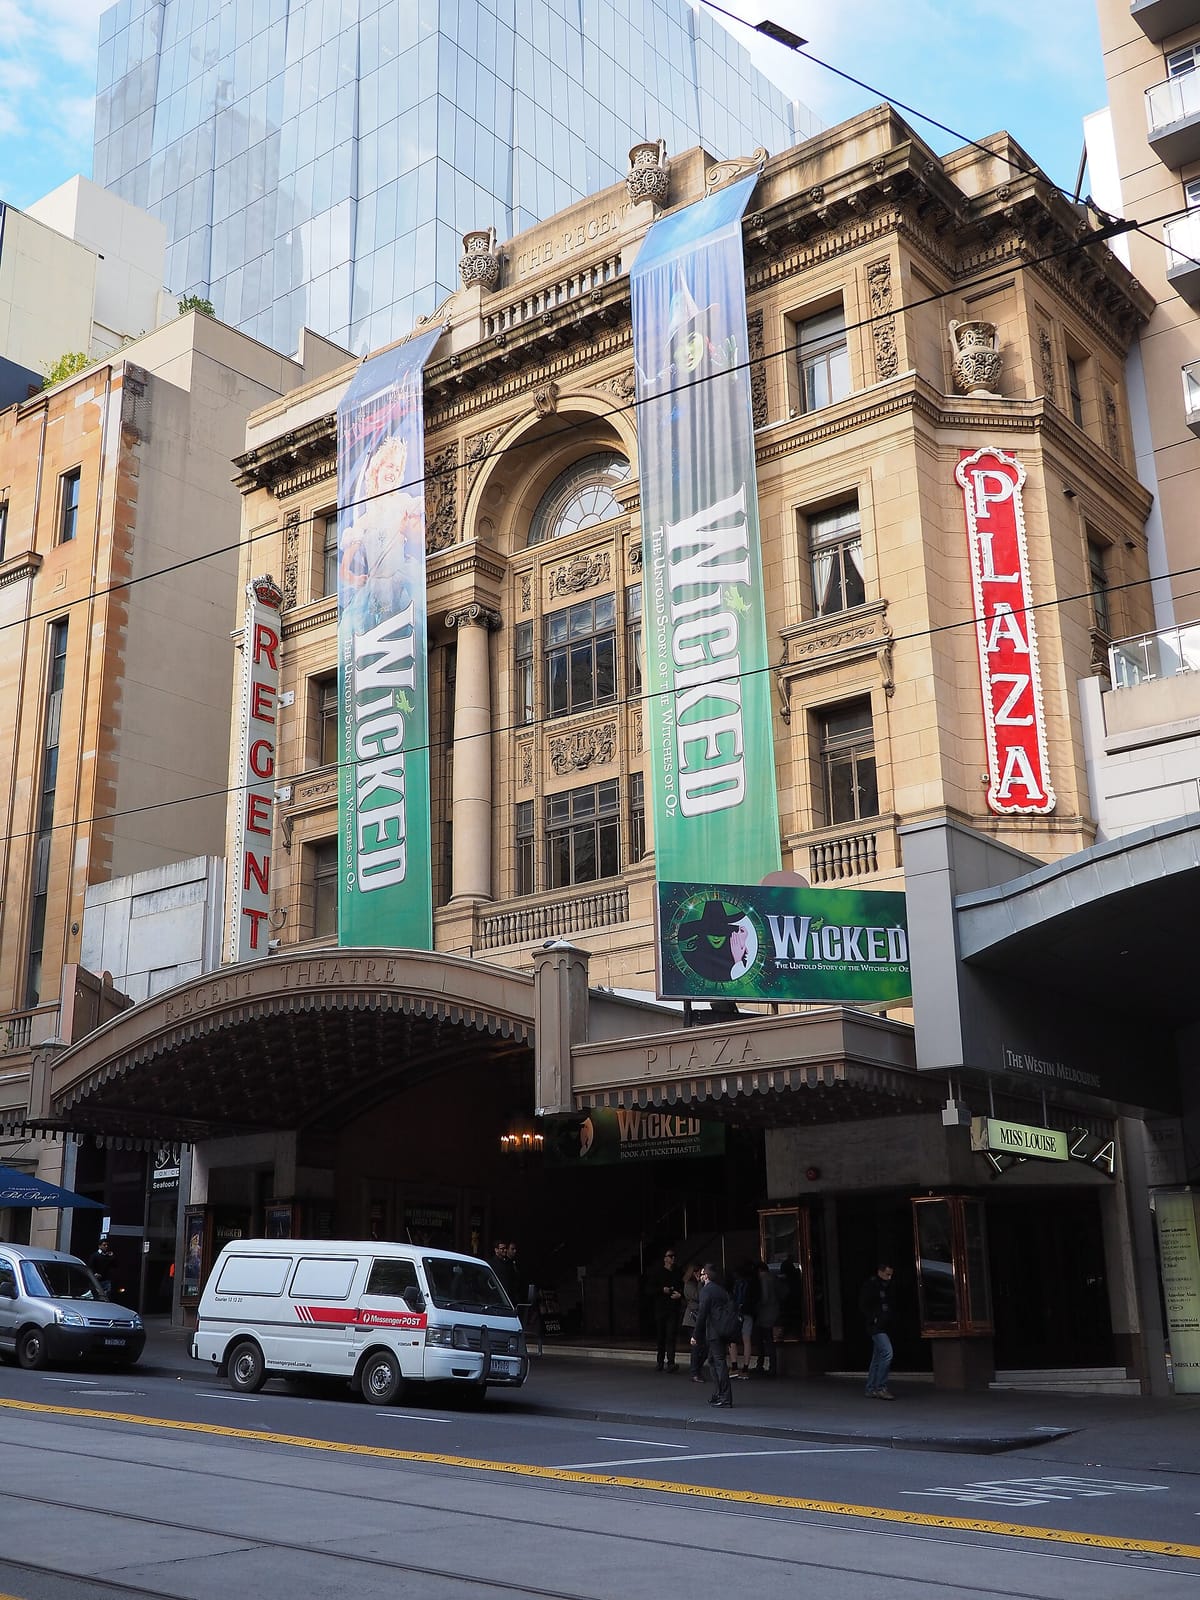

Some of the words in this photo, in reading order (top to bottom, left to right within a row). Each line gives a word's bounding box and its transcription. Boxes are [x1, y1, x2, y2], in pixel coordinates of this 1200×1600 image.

[519, 241, 553, 274] THE
[654, 556, 666, 614] UNTOLD
[656, 615, 669, 658] STORY
[971, 469, 1044, 800] PLAZA
[243, 622, 279, 949] REGENT
[818, 963, 838, 971] STORY
[163, 972, 255, 1023] REGENT
[280, 959, 397, 988] THEATRE
[643, 1033, 760, 1076] PLAZA
[1006, 1050, 1024, 1069] THE
[1024, 1054, 1055, 1077] WESTIN
[1000, 1127, 1023, 1147] MISS
[1024, 1131, 1057, 1153] LOUISE
[153, 1180, 175, 1189] Seafood
